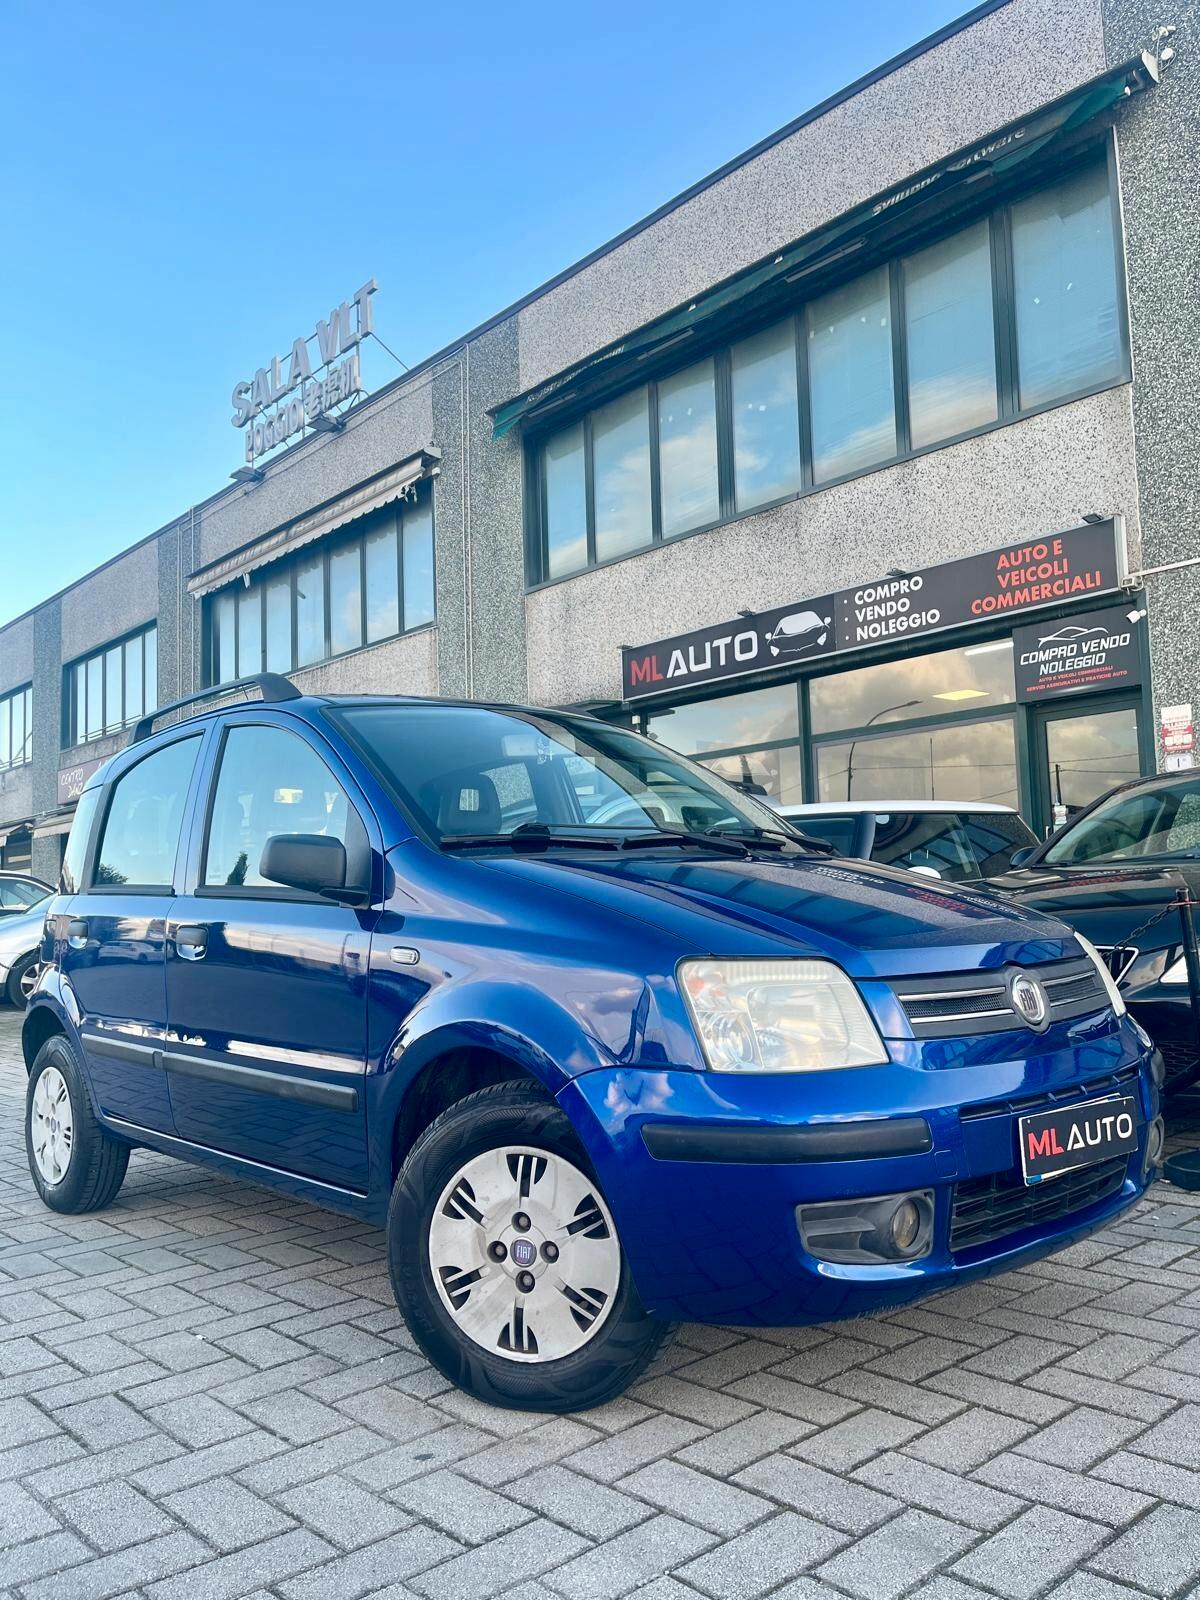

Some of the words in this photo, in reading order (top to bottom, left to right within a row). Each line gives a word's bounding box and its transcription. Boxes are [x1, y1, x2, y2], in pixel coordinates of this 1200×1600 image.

[231, 337, 313, 428] SALA
[315, 278, 379, 366] VLT
[996, 542, 1048, 571] AUTO
[1052, 538, 1063, 556] E
[996, 558, 1069, 589] VEICOLI
[854, 576, 923, 606] COMPRO
[971, 570, 1102, 615] COMMERCIALI
[855, 598, 910, 624] VENDO
[855, 608, 941, 642] NOLEGGIO
[666, 630, 759, 679] AUTO
[1020, 643, 1078, 666] COMPRO
[1081, 633, 1131, 654] VENDO
[1039, 652, 1107, 676] NOLEGGIO
[1038, 675, 1053, 683] AUTO
[1057, 672, 1077, 680] VEICOLI
[1077, 665, 1114, 676] COMMERCIALI
[1112, 670, 1128, 678] AUTO
[60, 767, 84, 786] CENTRO
[1067, 1113, 1133, 1151] AUTO
[516, 1245, 531, 1259] FIAT
